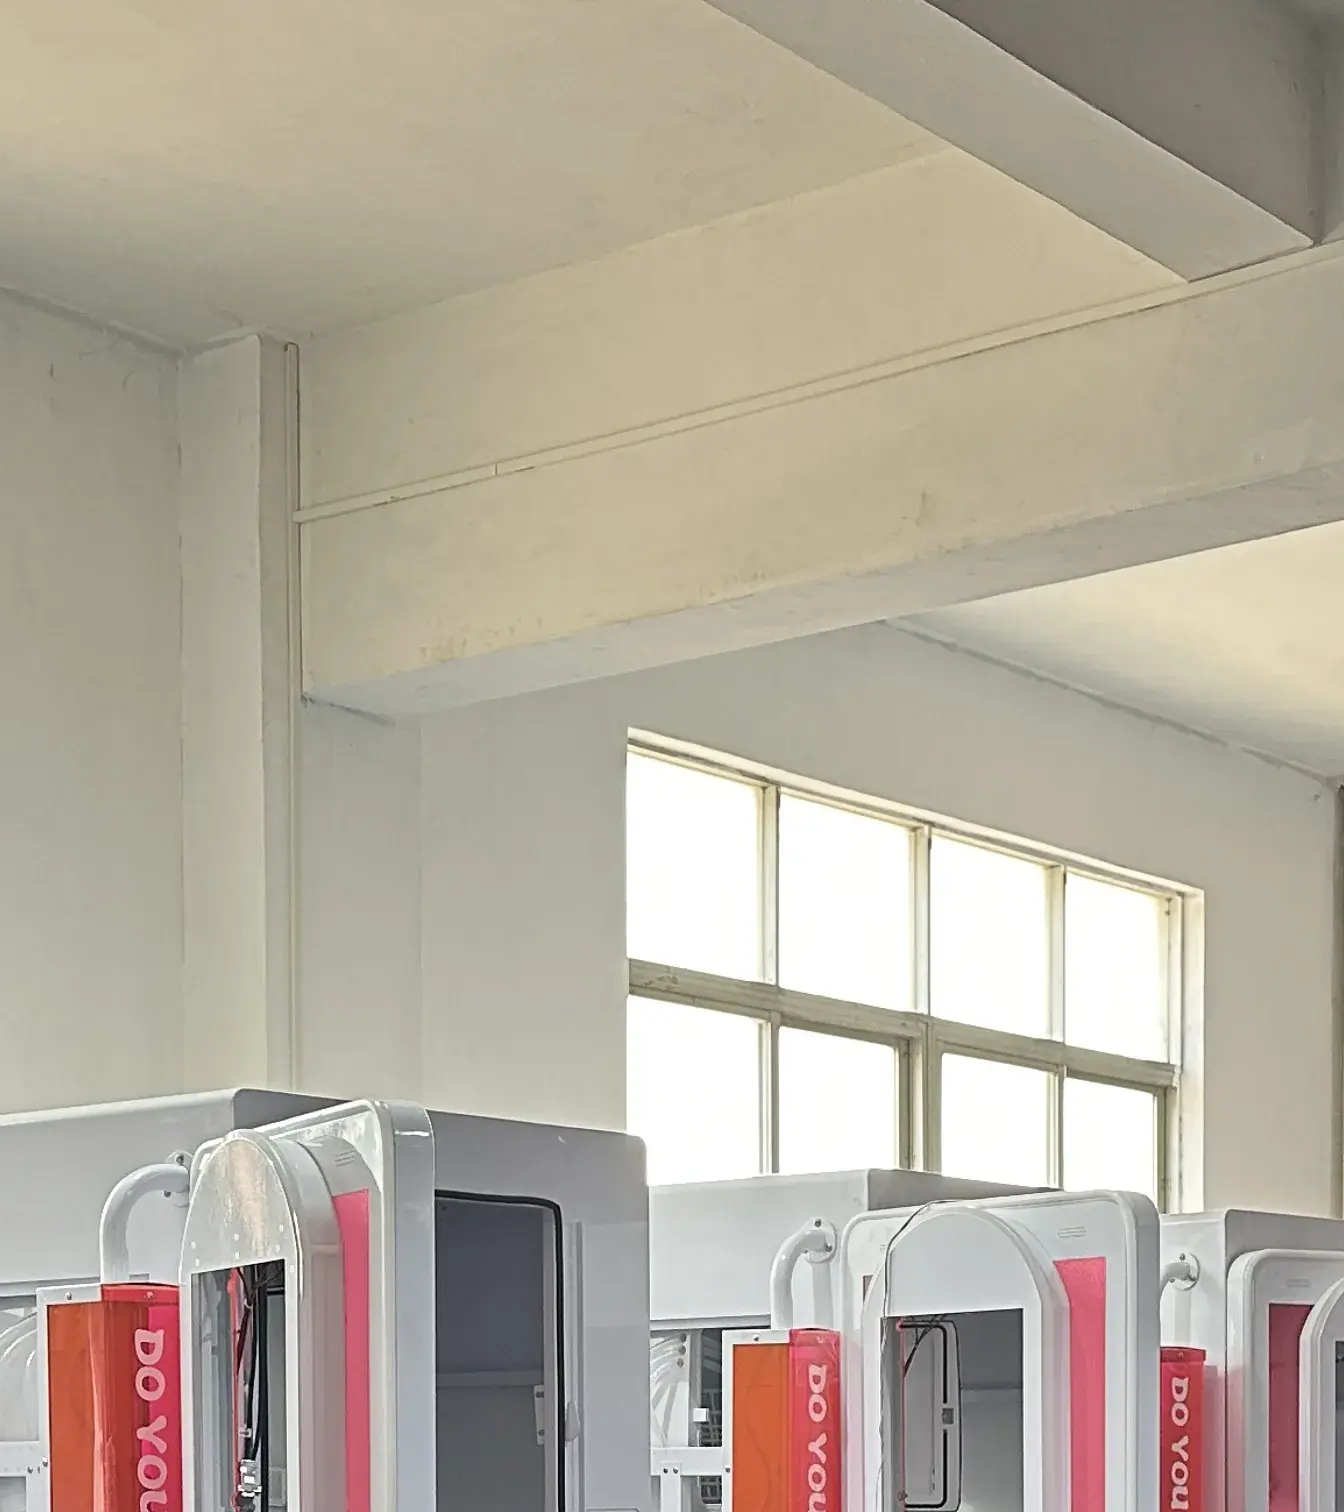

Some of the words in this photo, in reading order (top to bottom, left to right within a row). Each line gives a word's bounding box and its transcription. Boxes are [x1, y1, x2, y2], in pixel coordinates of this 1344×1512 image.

[134, 1328, 165, 1402] DO
[808, 1364, 828, 1423] DO
[1171, 1377, 1189, 1427] DO
[1171, 1435, 1189, 1510] YOU
